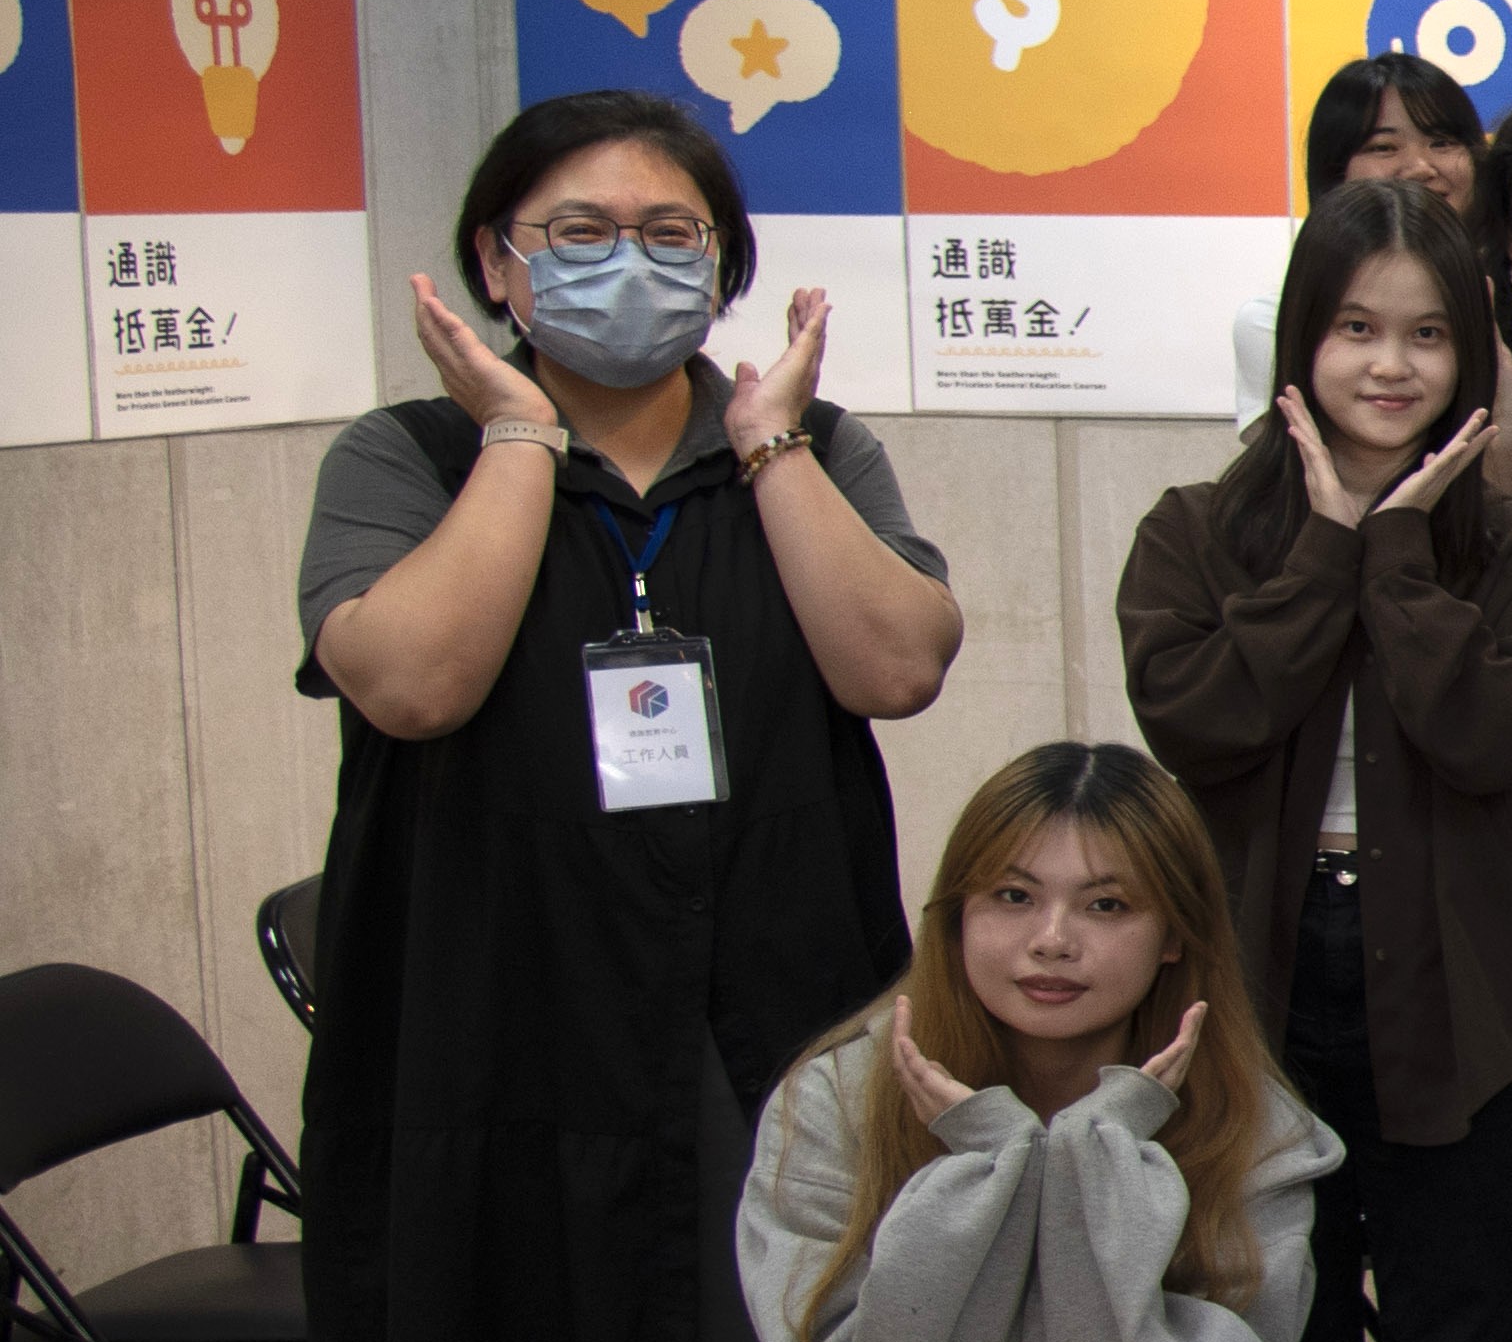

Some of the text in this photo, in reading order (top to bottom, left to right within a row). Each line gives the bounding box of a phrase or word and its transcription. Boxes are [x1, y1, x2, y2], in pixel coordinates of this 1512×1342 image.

[108, 241, 177, 288] 通識
[932, 238, 1017, 279] 通識
[622, 744, 690, 765] 工作人員
